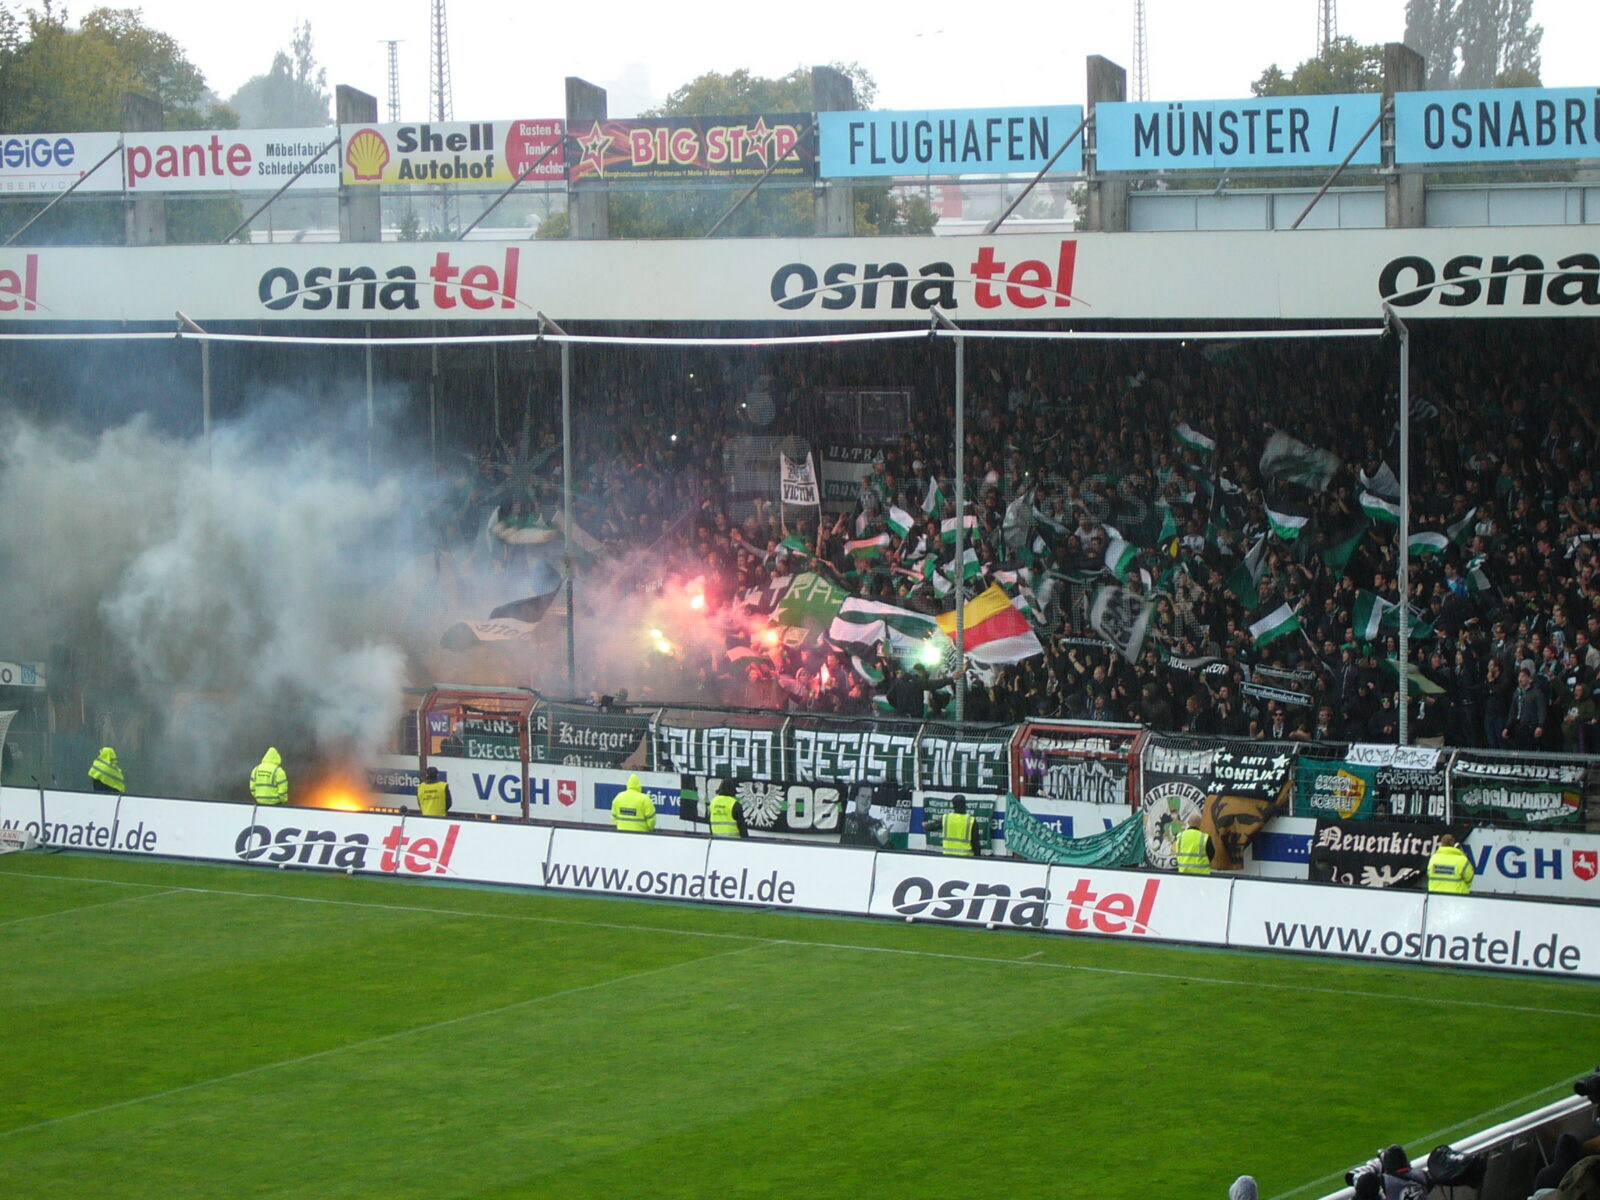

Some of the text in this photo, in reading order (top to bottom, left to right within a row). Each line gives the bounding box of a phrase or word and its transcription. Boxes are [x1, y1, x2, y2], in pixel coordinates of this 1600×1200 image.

[396, 123, 494, 153] Shell
[519, 122, 562, 137] Rasten &
[629, 126, 700, 166] BIG
[849, 117, 1049, 164] FLUGHAFEN
[1134, 104, 1310, 157] MÜNSTER
[127, 134, 253, 188] pante
[397, 154, 494, 180] Autohof
[258, 247, 520, 310] osnatel
[770, 239, 1078, 310] osnatel
[1378, 253, 1600, 307] osna
[1214, 766, 1286, 782] KONFLIKT
[1241, 755, 1268, 766] ANTI
[472, 773, 550, 806] VGH
[786, 785, 841, 830] 06
[235, 824, 461, 874] osnatel
[541, 861, 796, 904] www.osnatel.de
[892, 876, 1161, 935] osnatel
[1264, 921, 1582, 971] www.osnatel.de
